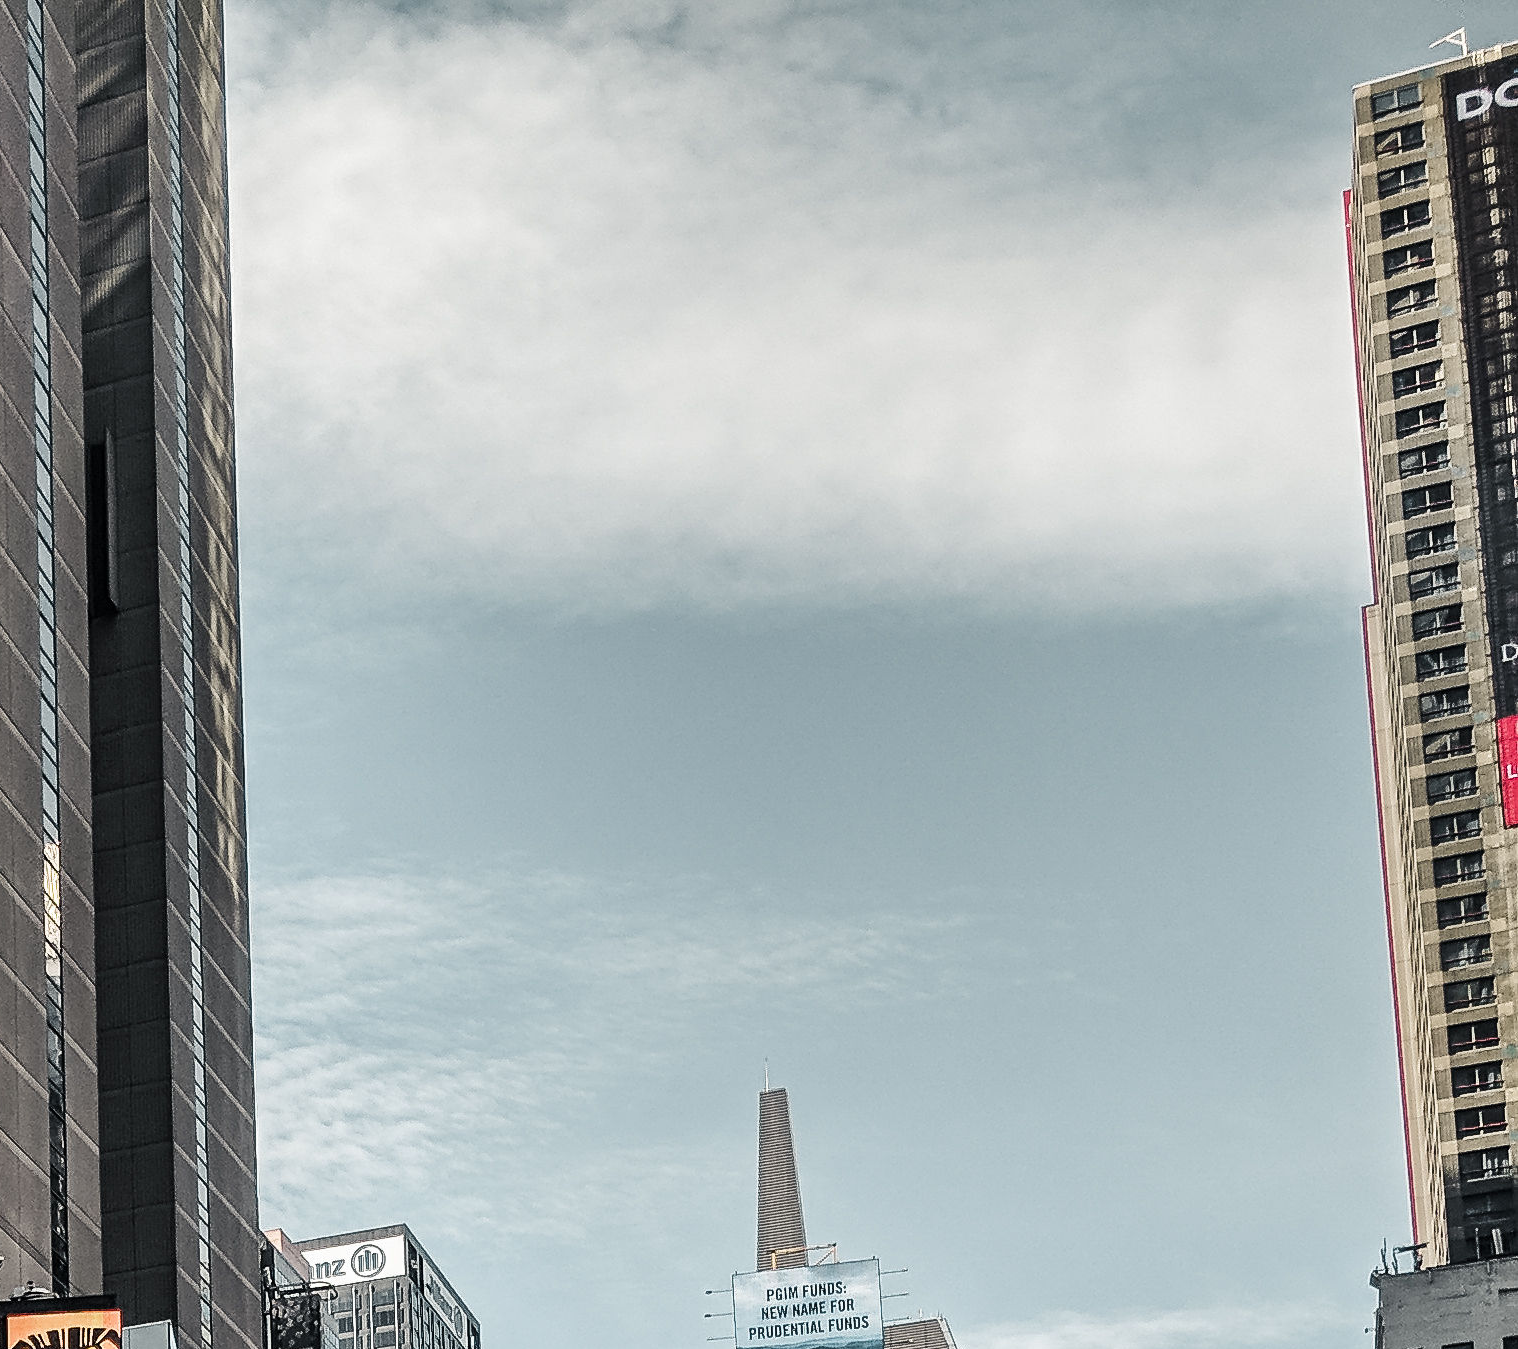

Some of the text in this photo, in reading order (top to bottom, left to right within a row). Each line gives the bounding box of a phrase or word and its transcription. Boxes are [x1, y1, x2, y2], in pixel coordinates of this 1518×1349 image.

[766, 1281, 847, 1302] PGIM FUNDS:
[761, 1299, 855, 1320] NEW NAME FOR
[749, 1316, 870, 1341] PRUDENTIAL FUNDS
